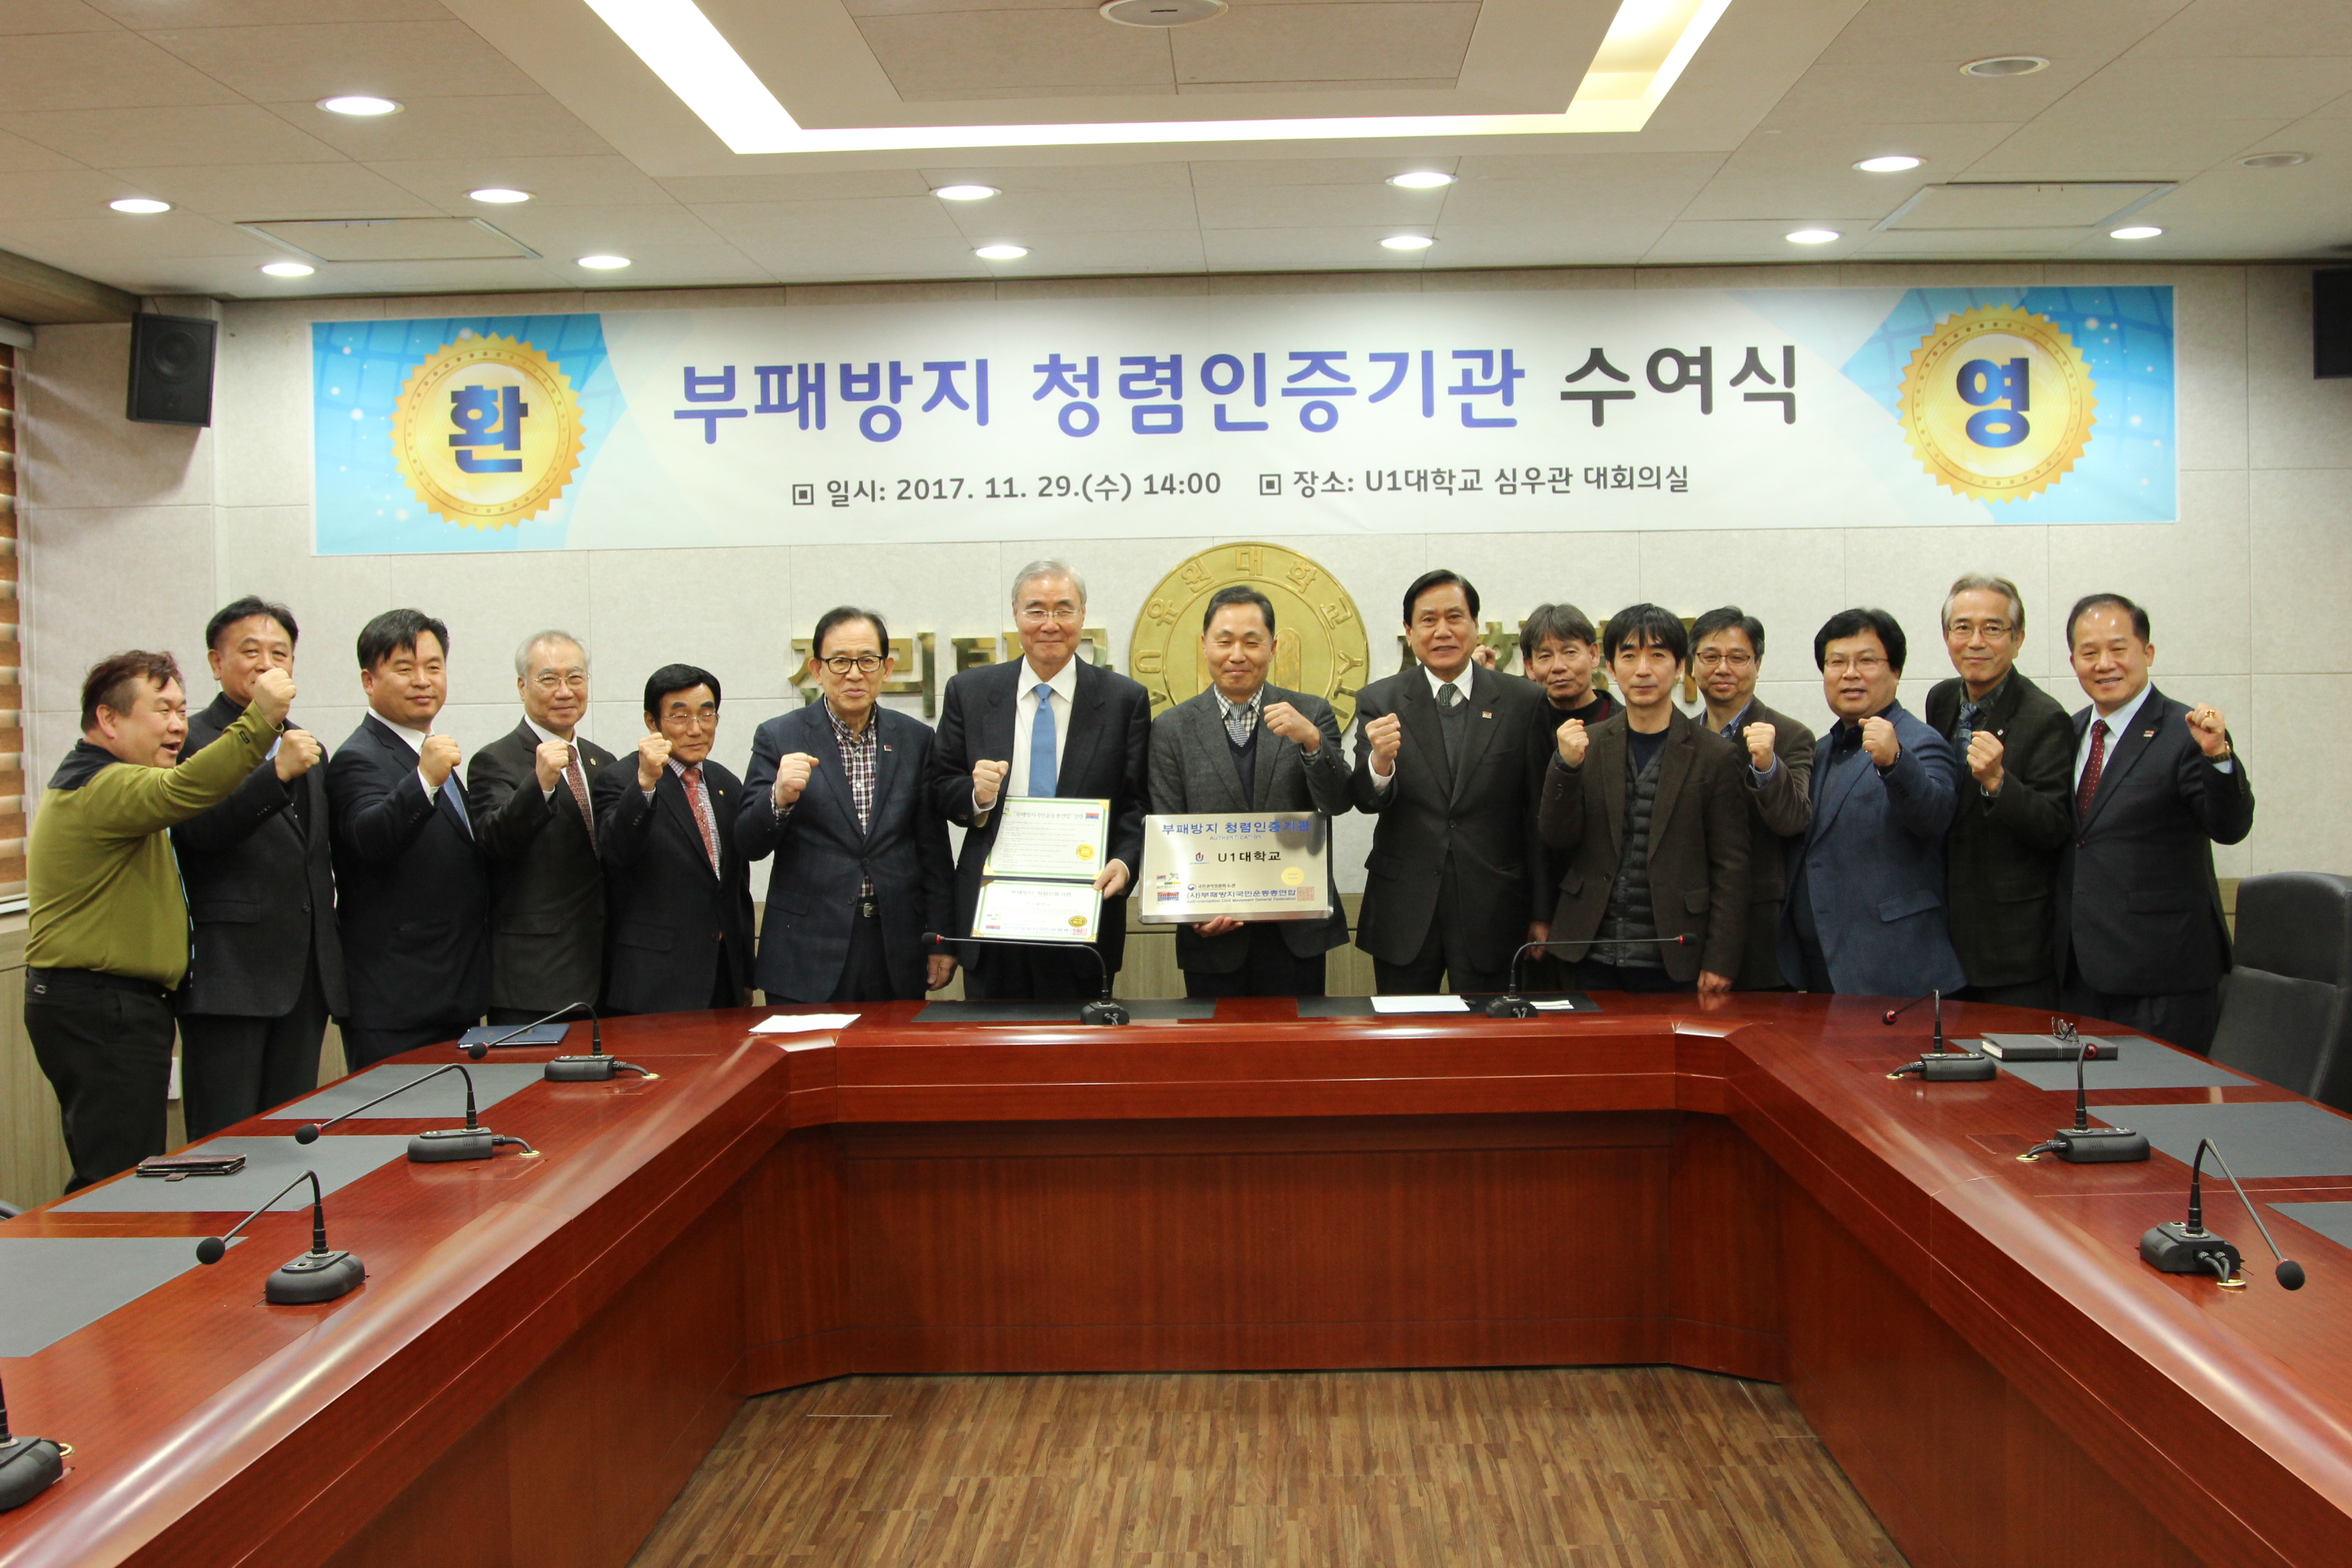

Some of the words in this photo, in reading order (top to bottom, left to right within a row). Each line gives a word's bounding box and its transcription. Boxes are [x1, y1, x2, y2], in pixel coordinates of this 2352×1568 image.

[674, 358, 990, 444] 부패방지
[1032, 348, 1525, 438] 청렴인증기관
[1560, 345, 1796, 427] 수여식
[1956, 357, 2031, 448] 영
[448, 385, 529, 474] 환
[826, 479, 885, 507] 일시:
[896, 478, 974, 500] 2017.
[985, 476, 1026, 499] 11.
[1038, 472, 1132, 503] 29.(수)
[1143, 472, 1222, 495] 14:00
[1293, 470, 1354, 498] 장소:
[1366, 468, 1484, 496] U1대학교
[1494, 467, 1573, 495] 심우관
[1584, 464, 1689, 493] 대회의실
[1147, 547, 1354, 630] 유원대학교
[1162, 823, 1218, 835] 부패방지
[1225, 821, 1311, 834] 청렴인증기관
[1218, 851, 1281, 862] U1대학교
